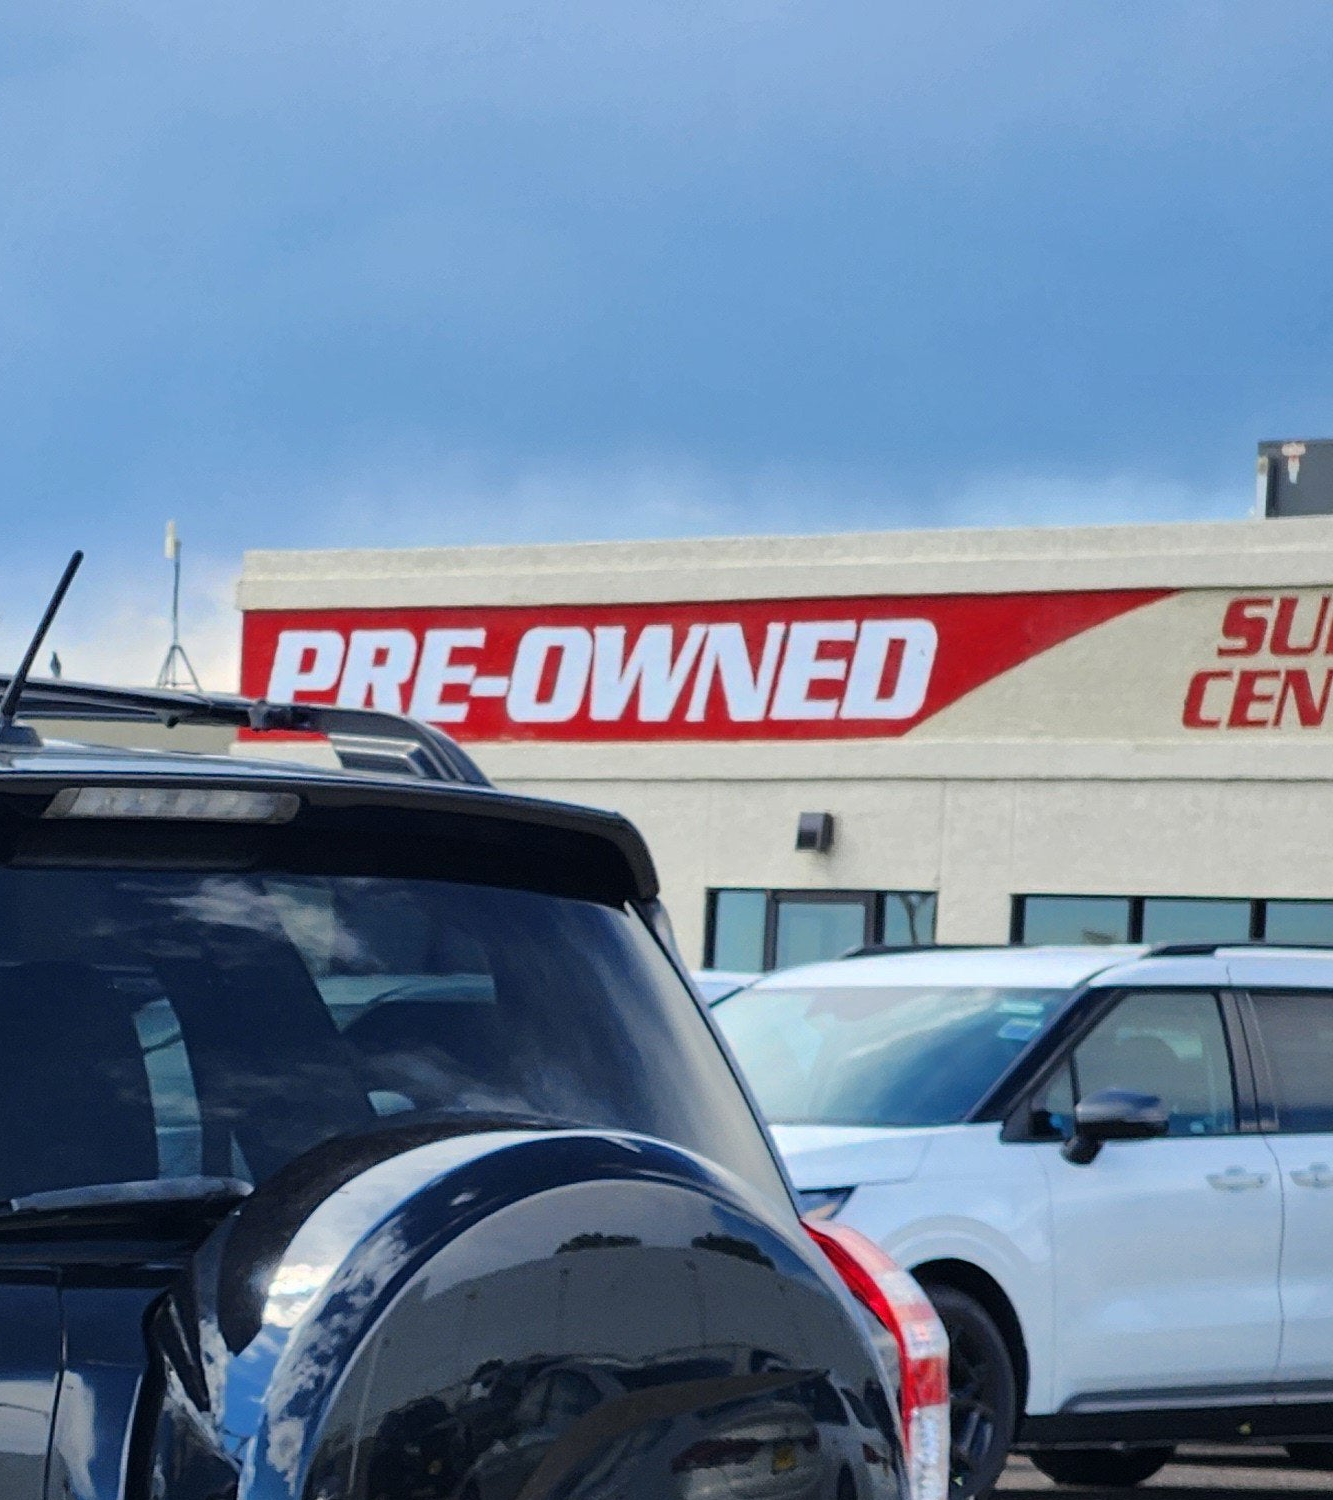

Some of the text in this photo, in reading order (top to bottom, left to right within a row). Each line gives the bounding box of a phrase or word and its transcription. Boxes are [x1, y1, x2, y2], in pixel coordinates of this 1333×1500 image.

[1217, 594, 1333, 657] SU
[266, 617, 937, 722] PRE-OWNED
[1182, 668, 1333, 728] CEN
